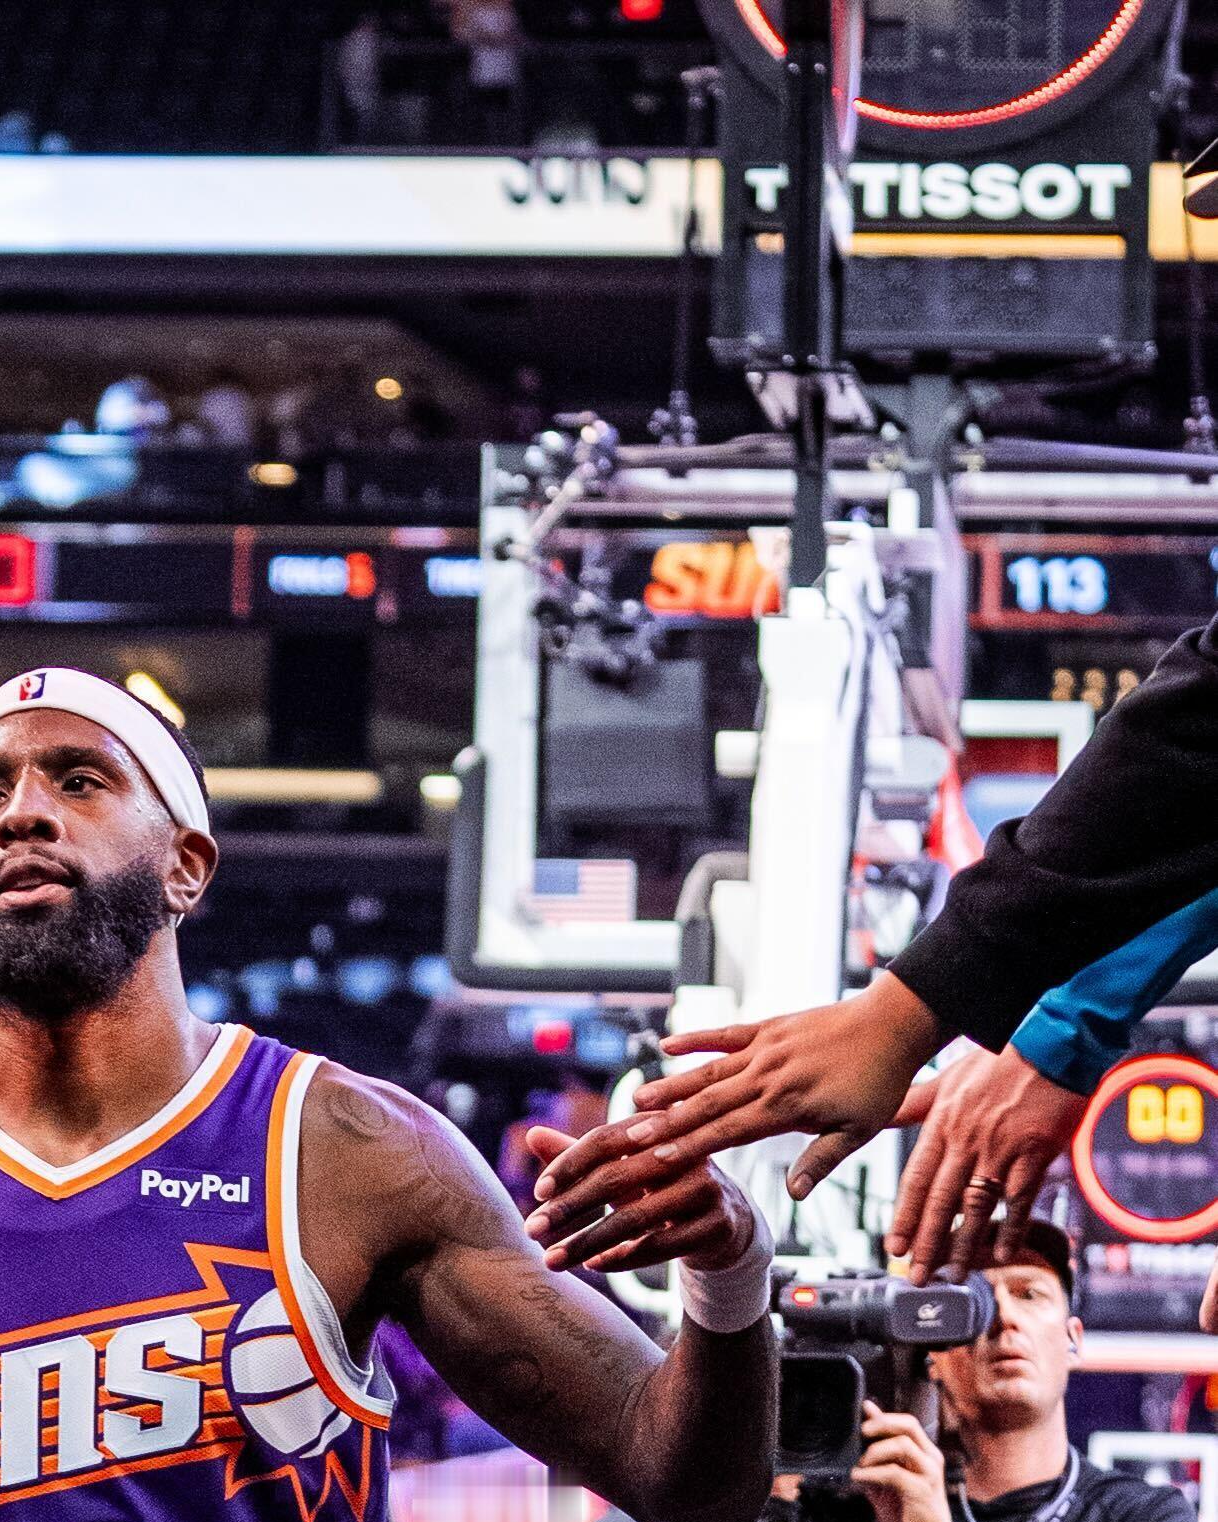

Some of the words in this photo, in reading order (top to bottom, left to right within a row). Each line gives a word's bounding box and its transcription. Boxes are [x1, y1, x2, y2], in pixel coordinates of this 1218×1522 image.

[848, 163, 1131, 219] TISSOT
[1007, 557, 1109, 615] 113
[1127, 1084, 1204, 1144] 00
[140, 1169, 250, 1207] PayPal
